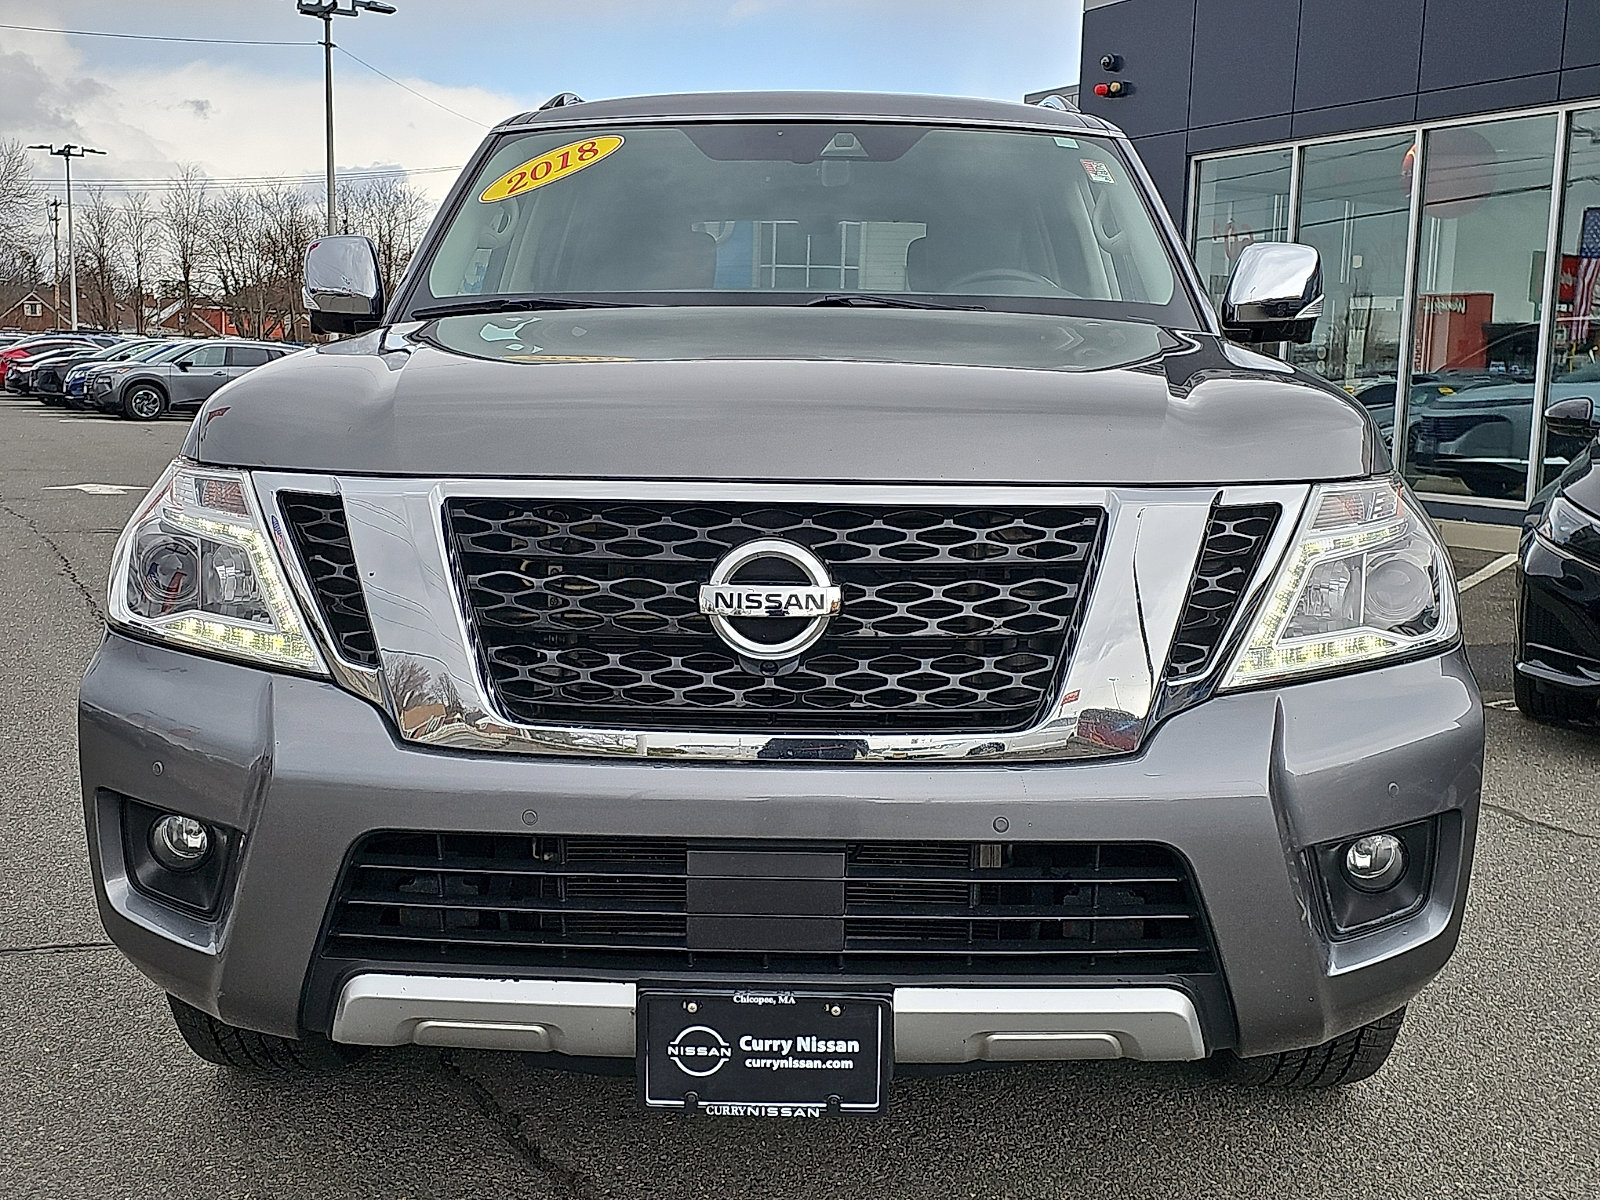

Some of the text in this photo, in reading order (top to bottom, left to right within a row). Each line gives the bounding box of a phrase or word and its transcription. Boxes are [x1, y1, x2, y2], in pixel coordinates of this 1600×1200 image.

[507, 141, 599, 194] 2018
[714, 592, 825, 610] NISSAN
[733, 995, 796, 1005] Chicopee, MA
[667, 1045, 732, 1057] NISSAN
[739, 1035, 860, 1055] Curry Nissan
[745, 1057, 854, 1070] currynissan.com
